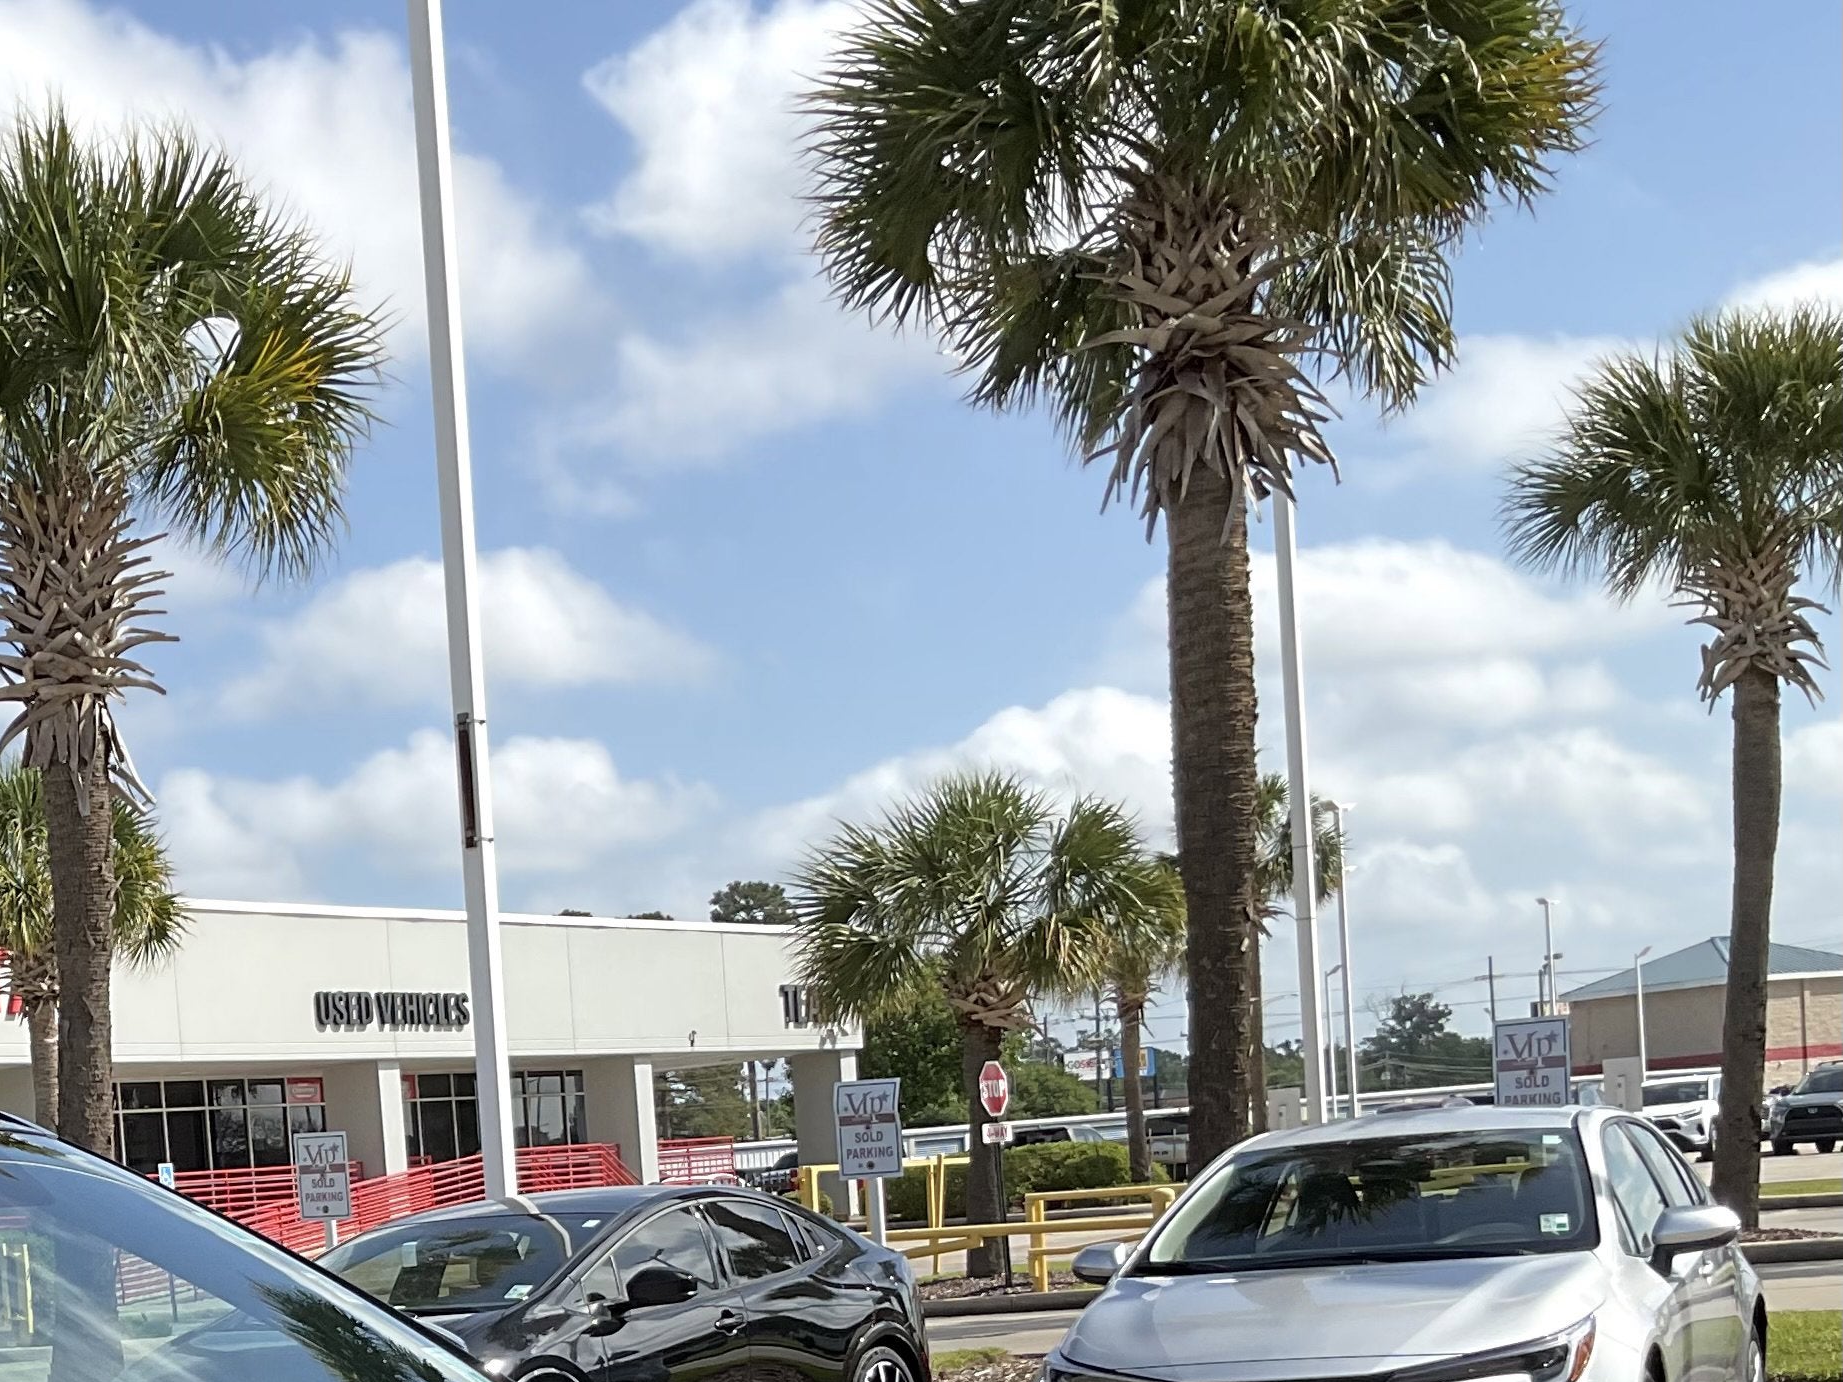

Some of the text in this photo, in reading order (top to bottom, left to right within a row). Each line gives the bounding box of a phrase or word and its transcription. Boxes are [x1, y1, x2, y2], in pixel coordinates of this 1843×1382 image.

[314, 991, 470, 1025] USED VEHICLES
[981, 1079, 1006, 1098] STOP
[1515, 1075, 1550, 1089] SOLD
[1504, 1092, 1561, 1105] PARKING
[854, 1131, 883, 1143] SOLD
[846, 1146, 894, 1160] PARKING
[312, 1178, 335, 1189] SOLD
[305, 1192, 344, 1203] PARKING
